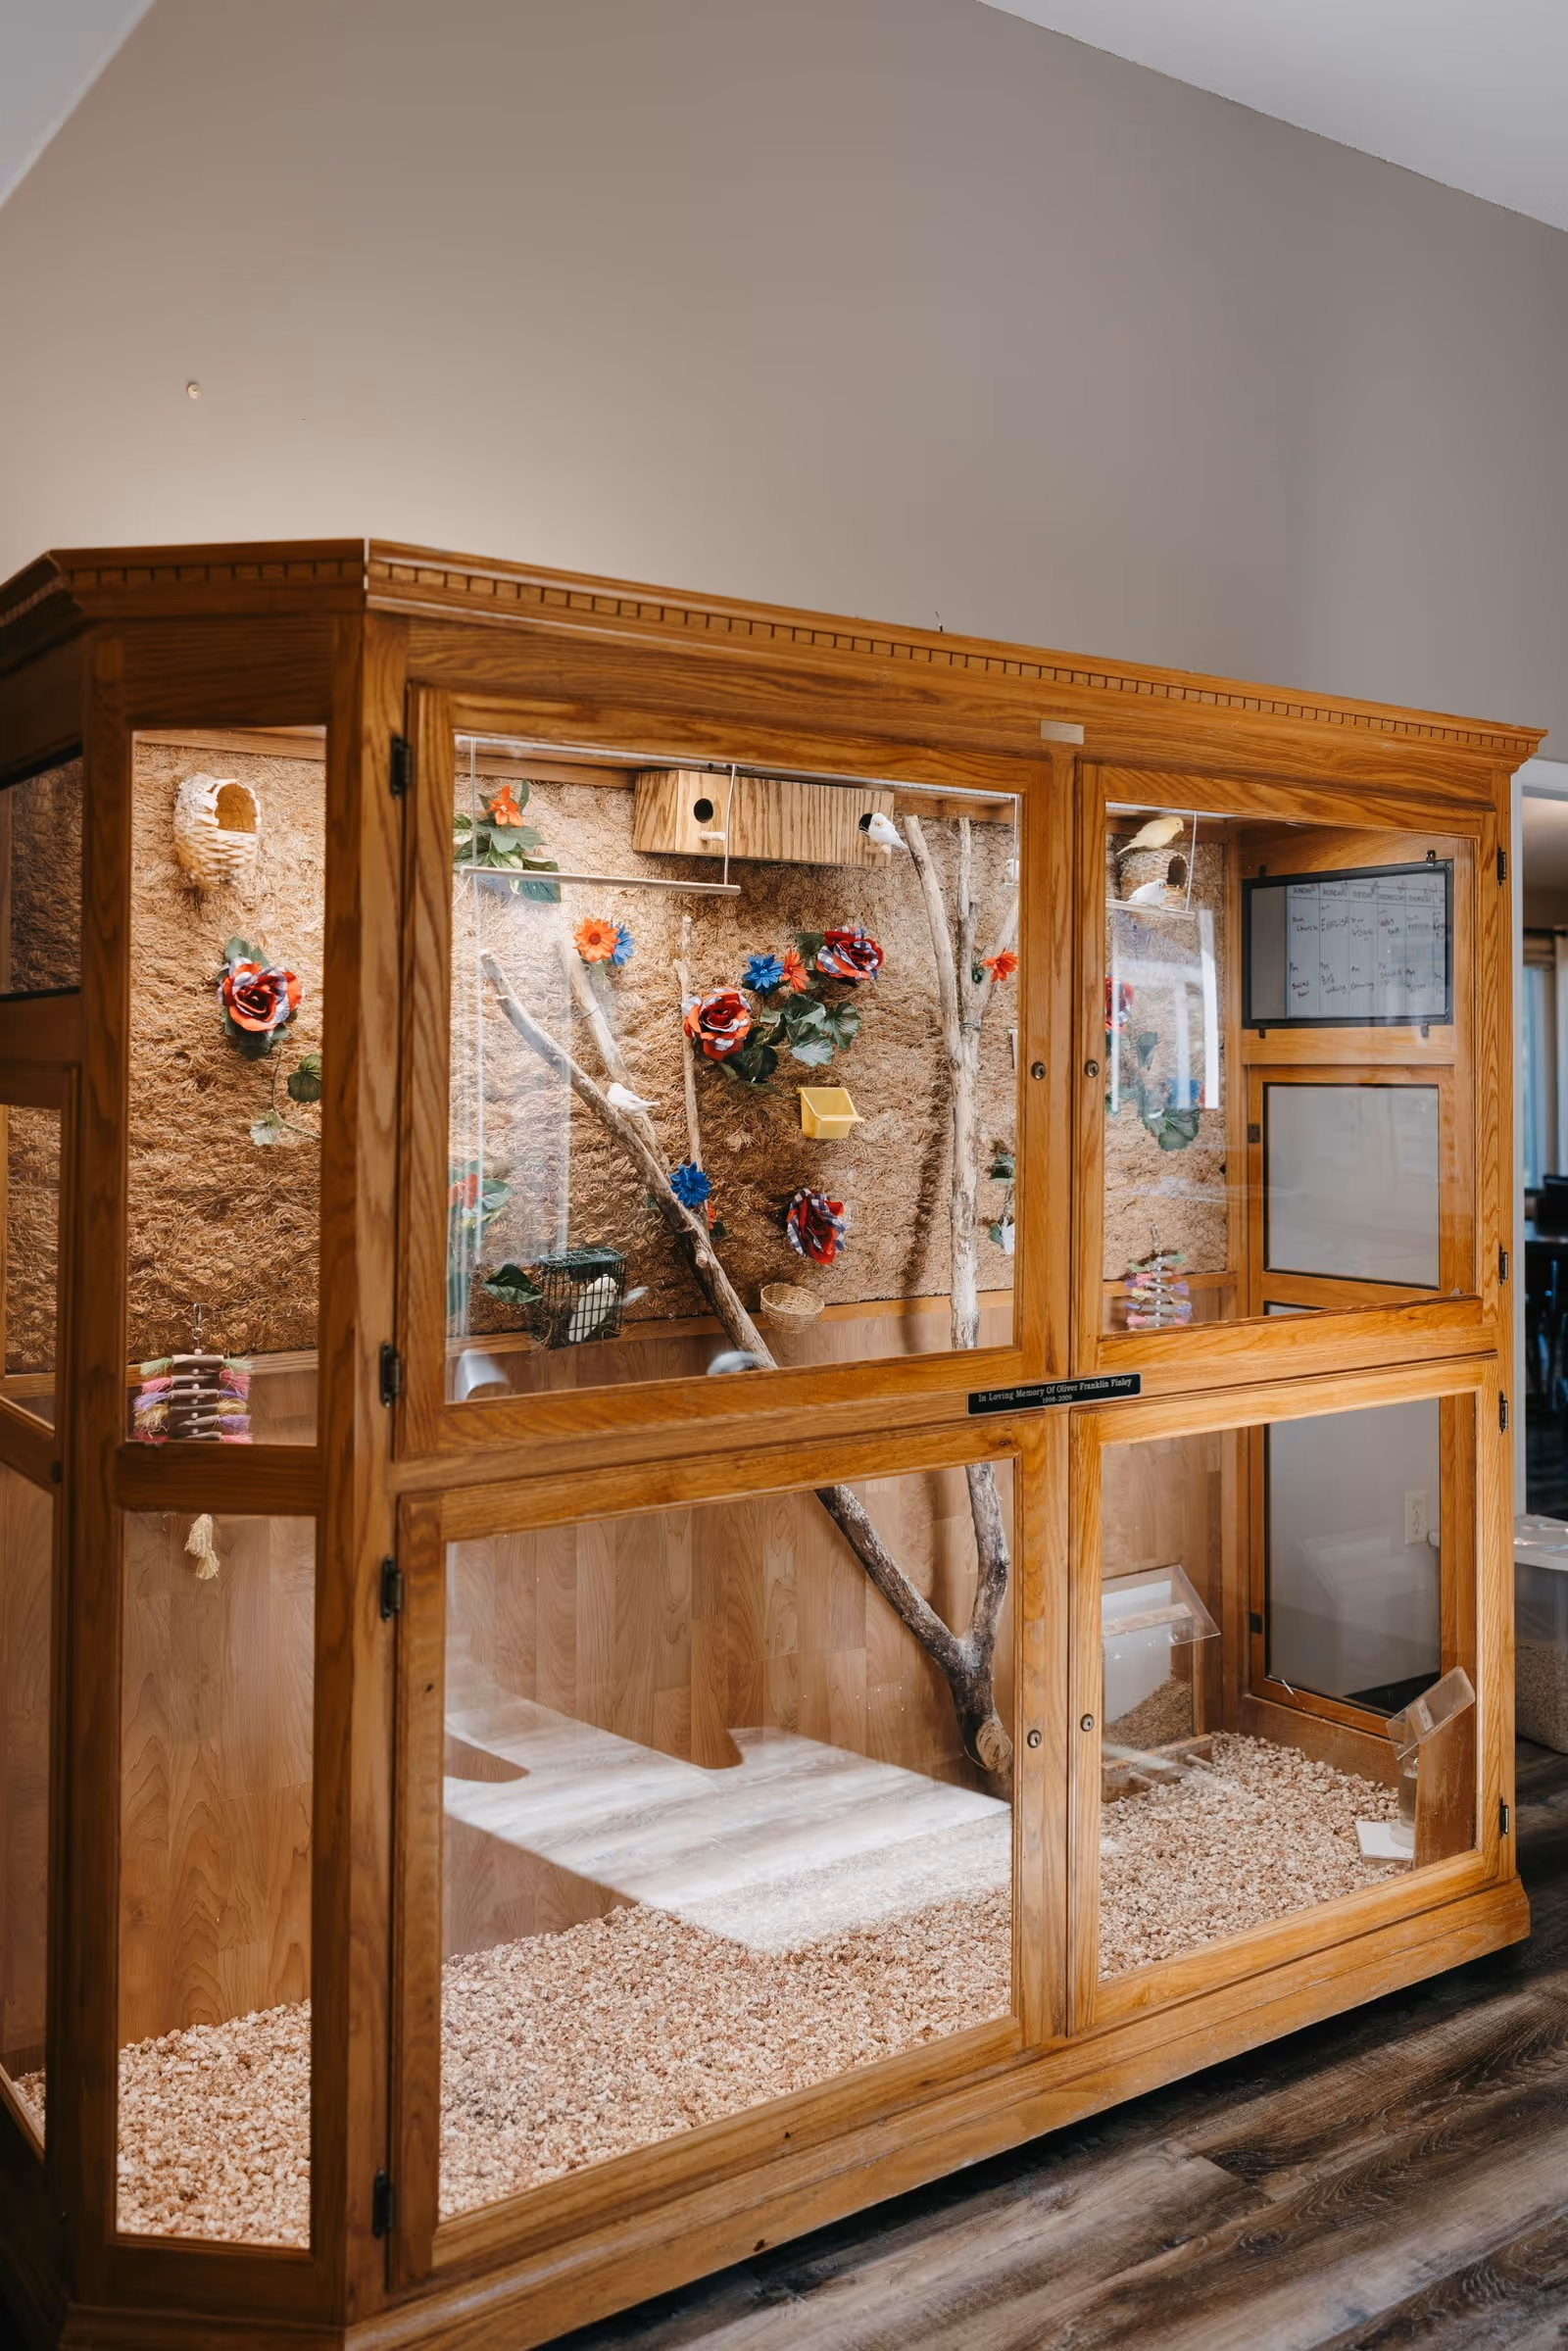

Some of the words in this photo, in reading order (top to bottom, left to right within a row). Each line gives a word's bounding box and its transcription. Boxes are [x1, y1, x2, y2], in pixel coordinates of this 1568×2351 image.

[978, 1394, 987, 1402] In
[988, 1392, 1014, 1401] Loving
[1015, 1389, 1045, 1398] Memory
[1046, 1385, 1055, 1395] Of
[1056, 1384, 1078, 1394] Oliver
[1079, 1380, 1109, 1391] Franklin
